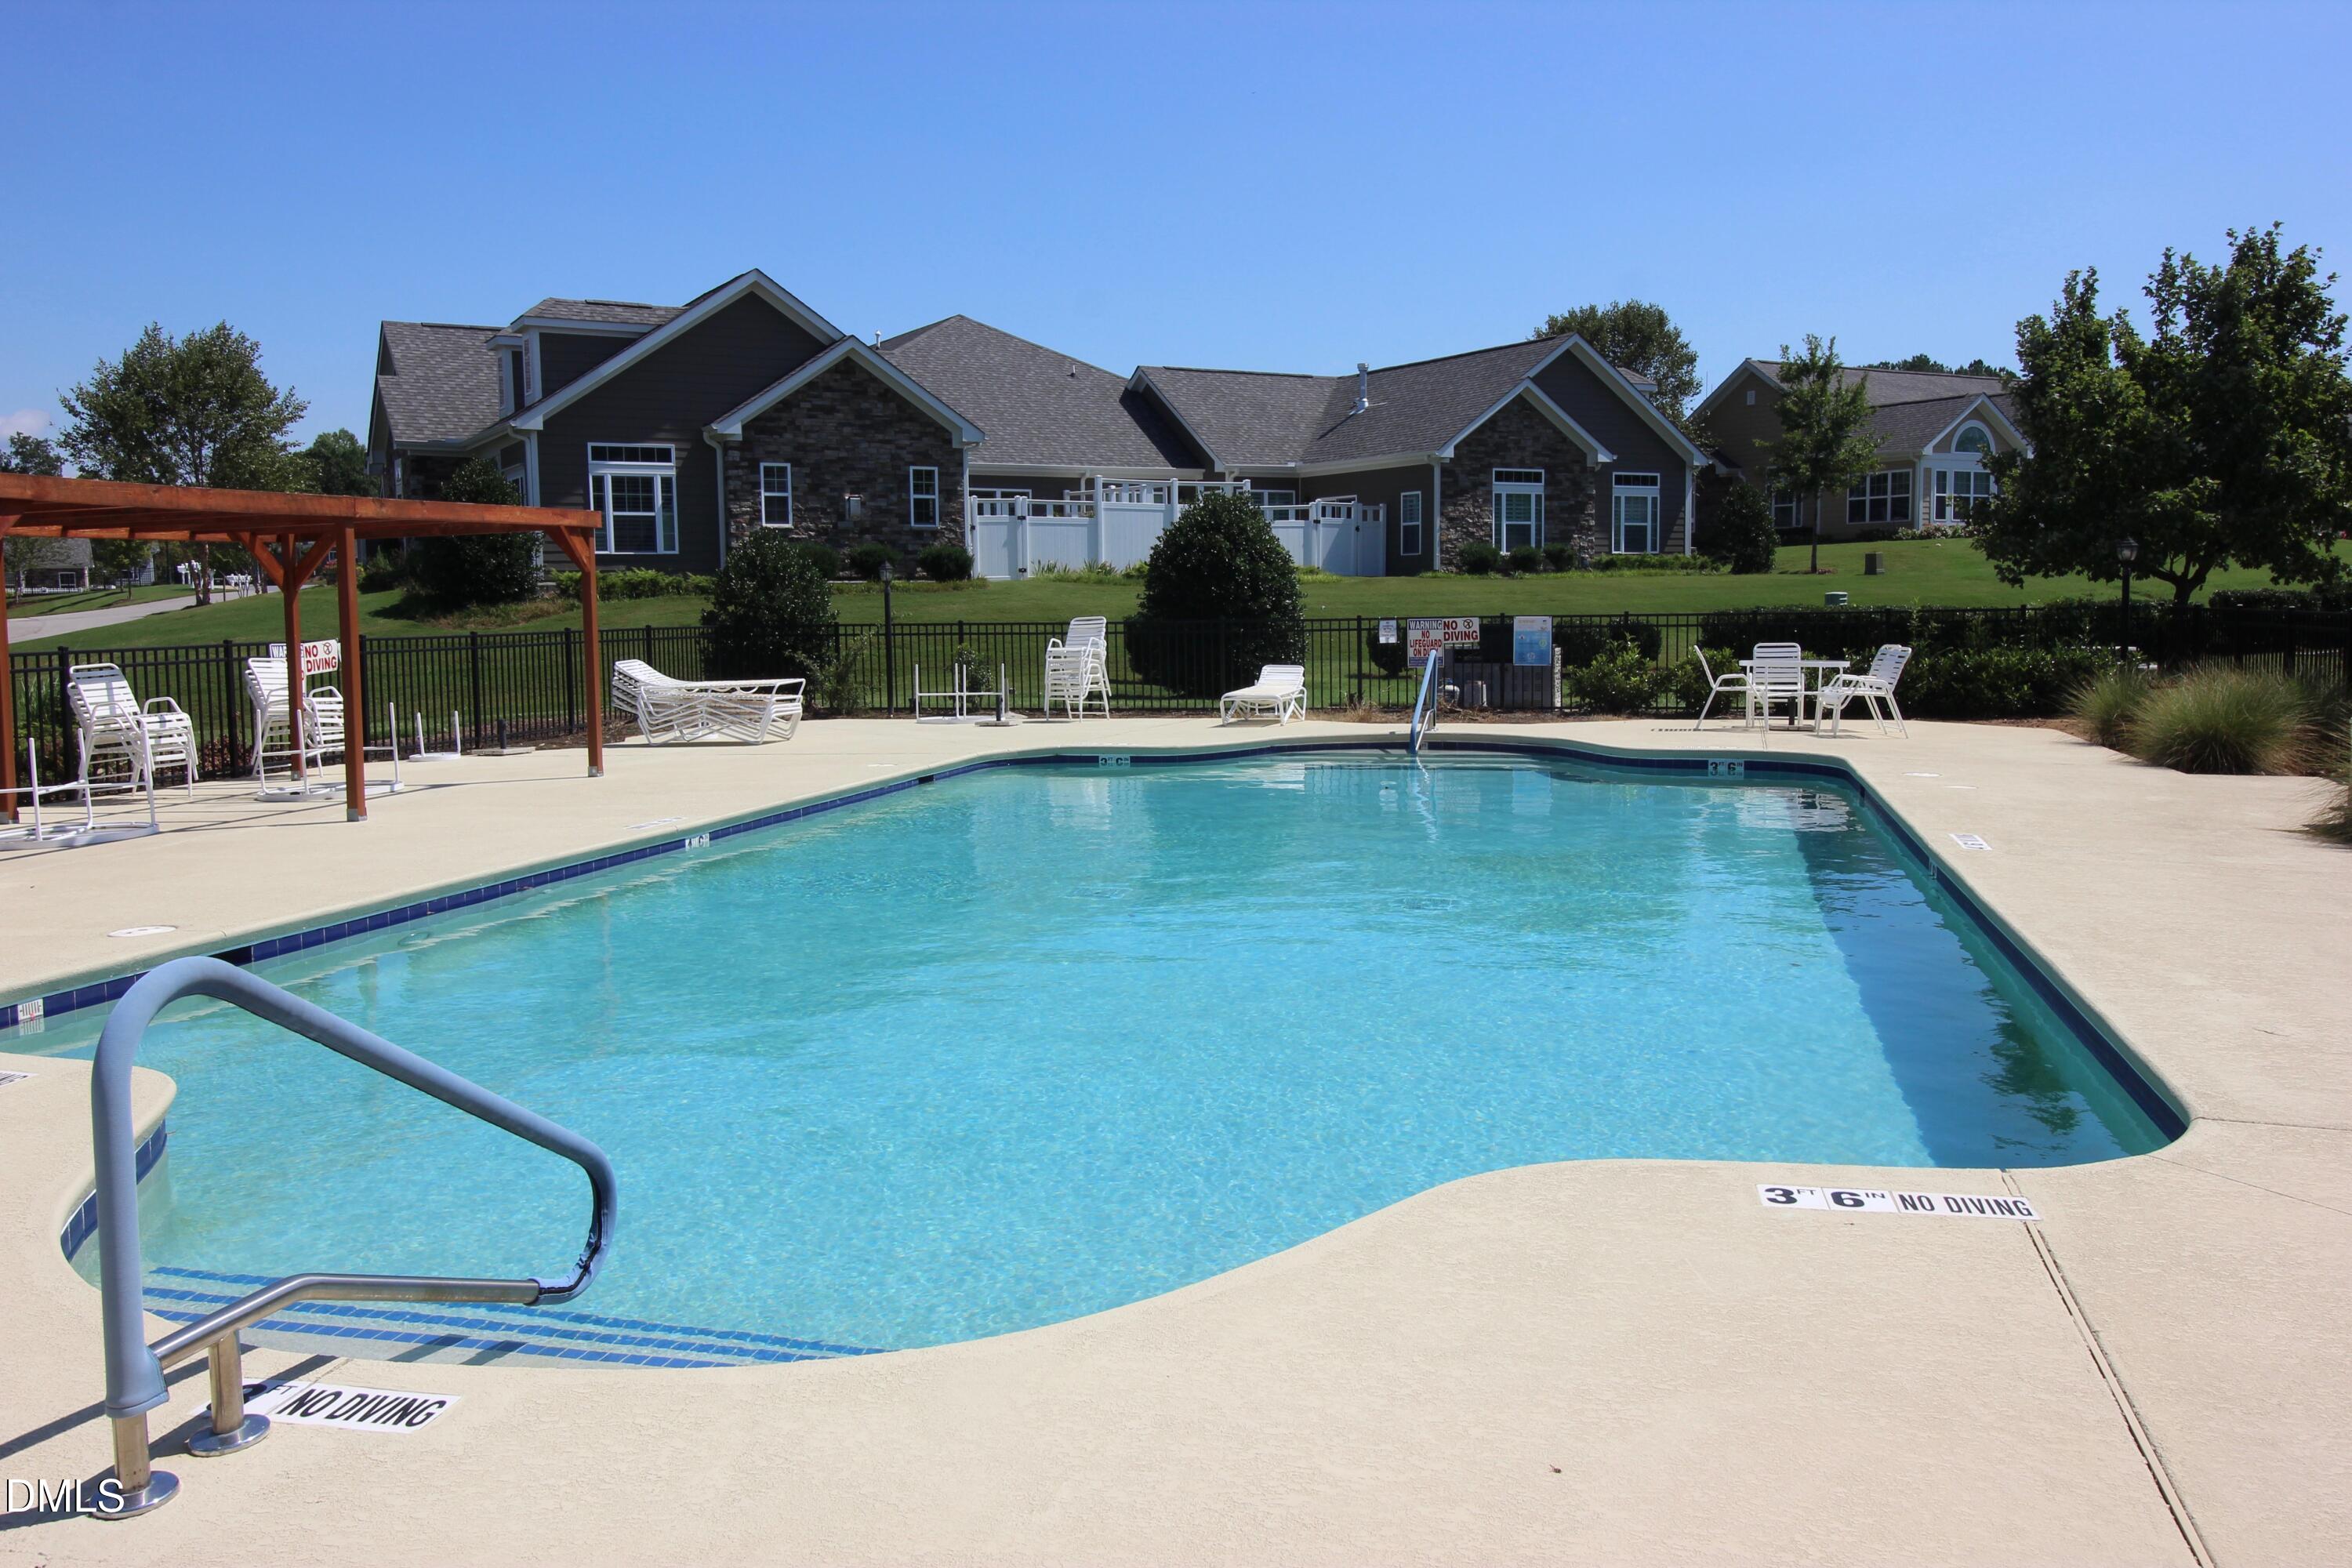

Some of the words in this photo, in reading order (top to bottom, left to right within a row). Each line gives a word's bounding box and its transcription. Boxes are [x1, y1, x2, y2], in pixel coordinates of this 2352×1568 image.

[1409, 620, 1443, 630] WARNING
[1443, 620, 1457, 631] NO
[1421, 630, 1430, 639] NO
[1443, 630, 1479, 641] DIVING
[1410, 639, 1443, 648] LIFEGUARD
[304, 644, 319, 659] NO
[306, 655, 337, 673] DIVING
[1897, 1193, 1936, 1212] NO
[1943, 1196, 2034, 1218] DIVING
[276, 1388, 343, 1418] NO
[323, 1391, 447, 1428] DIVING
